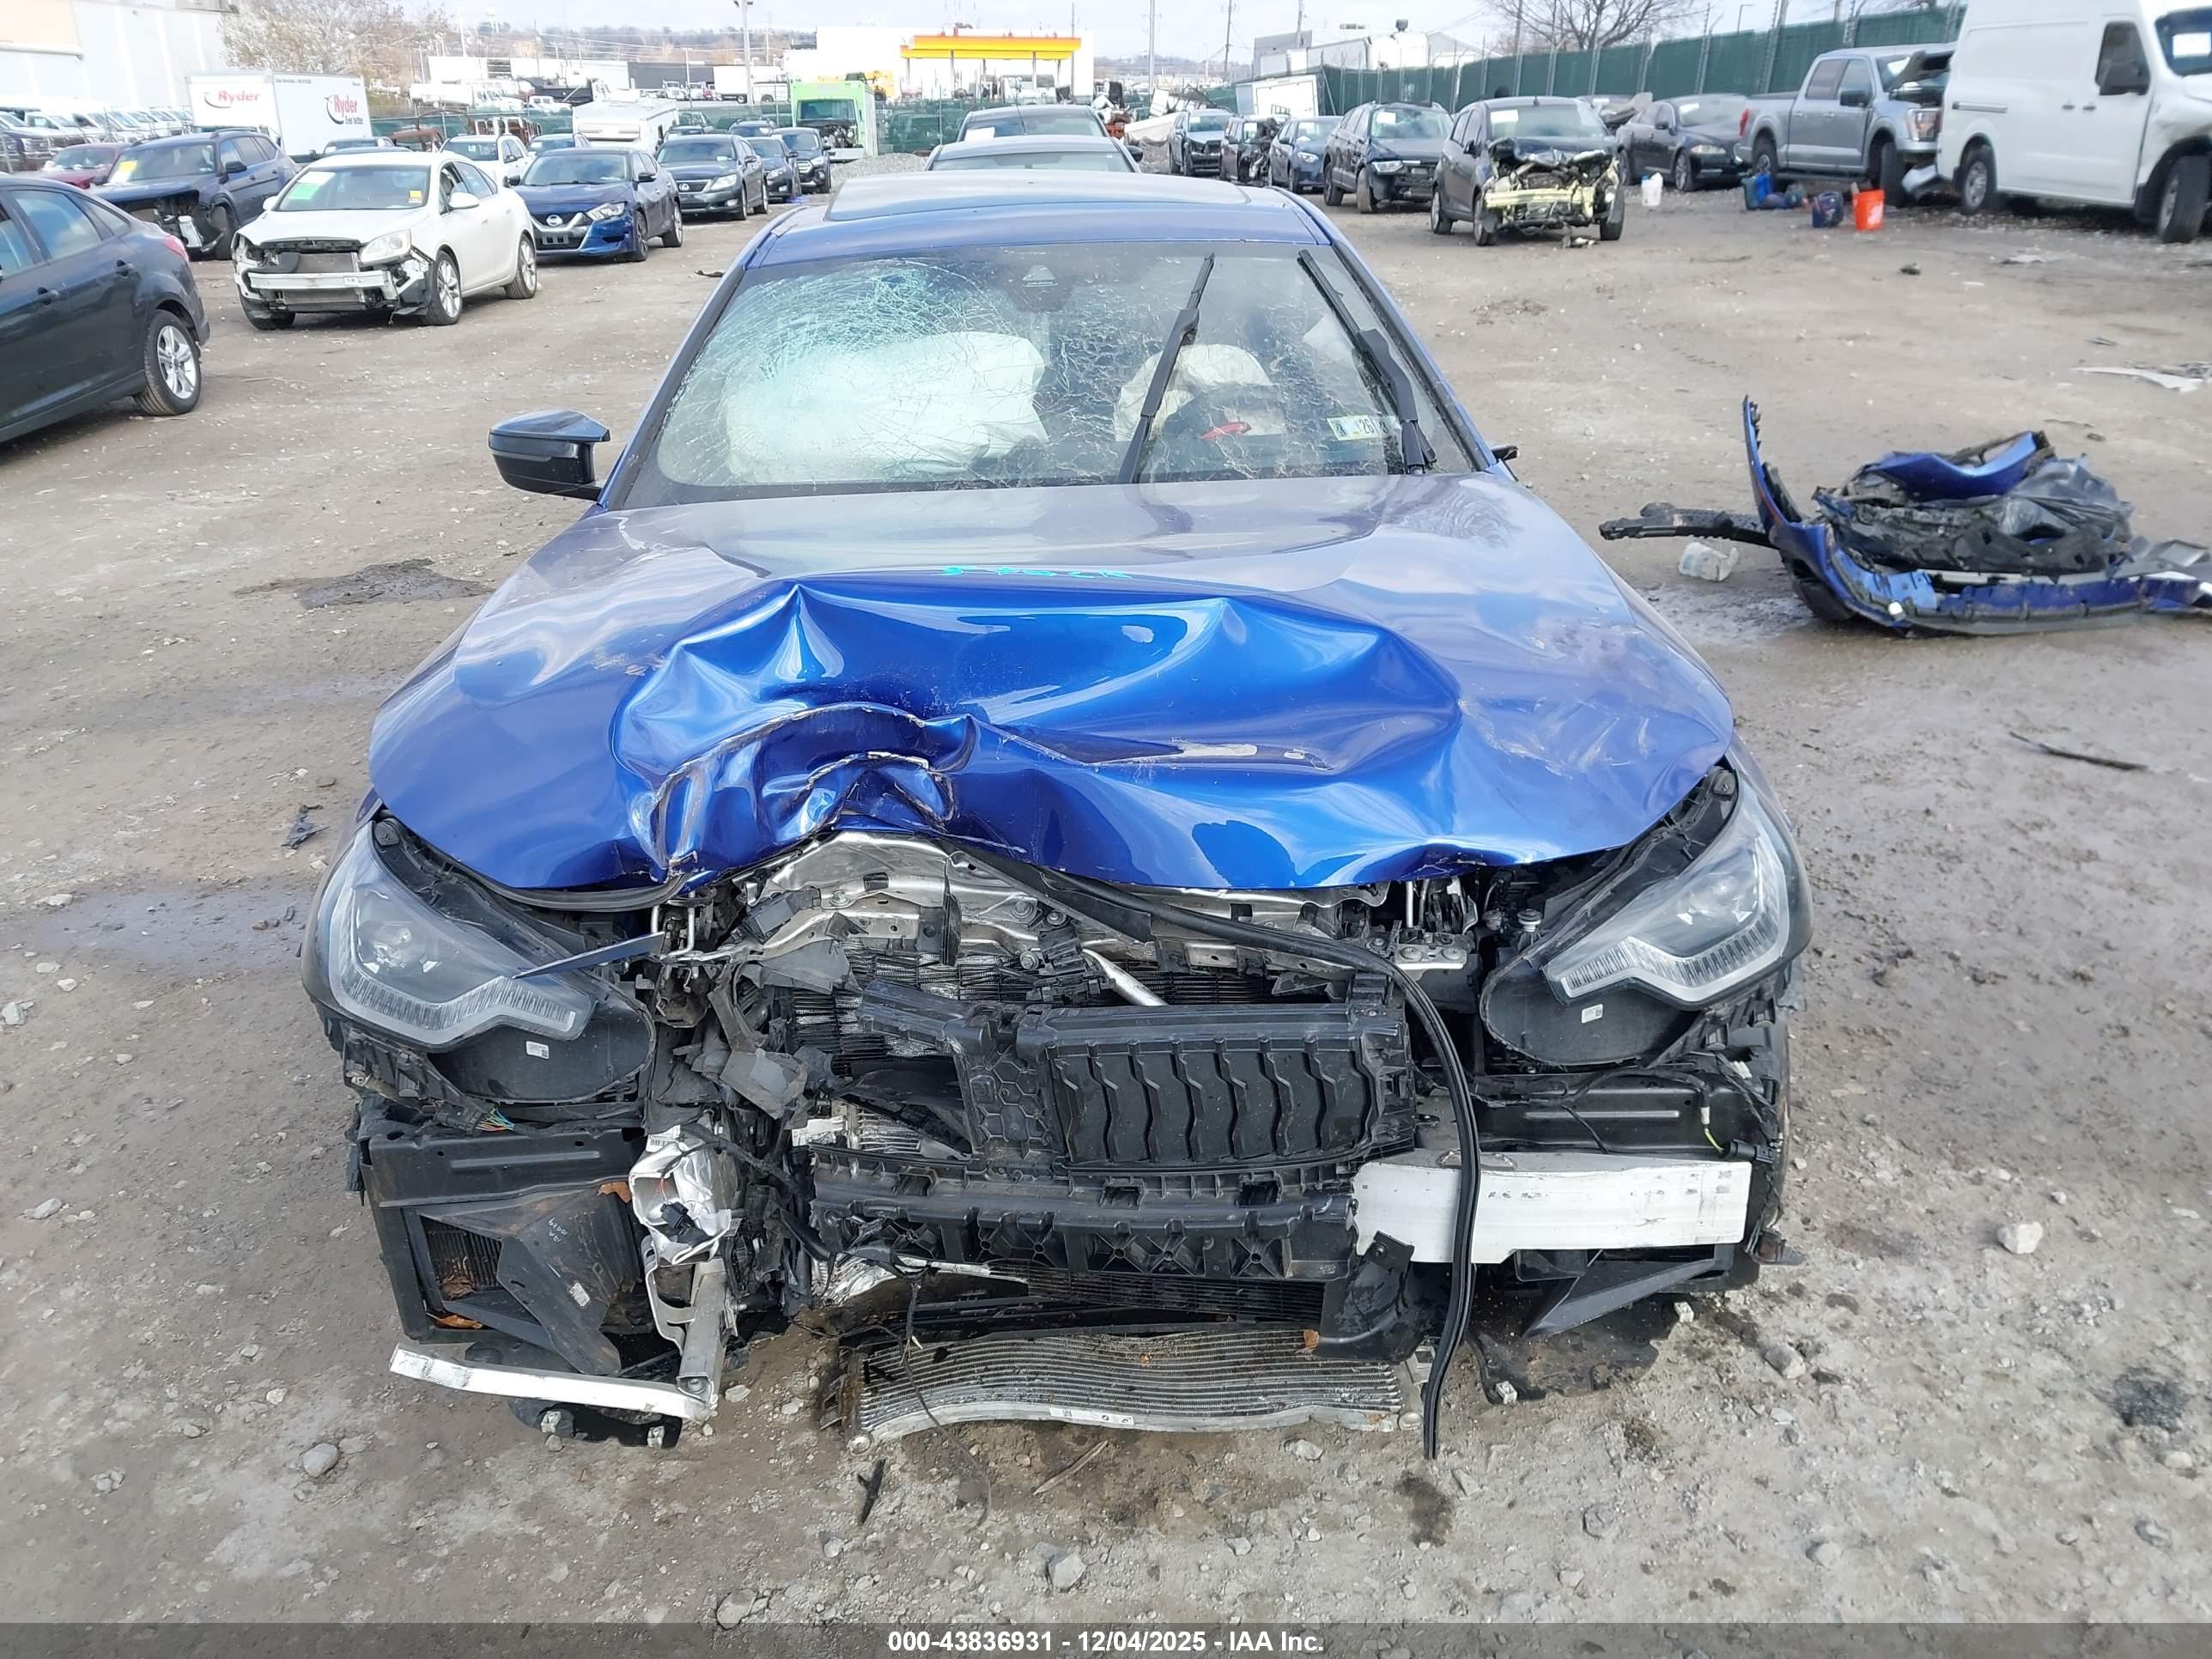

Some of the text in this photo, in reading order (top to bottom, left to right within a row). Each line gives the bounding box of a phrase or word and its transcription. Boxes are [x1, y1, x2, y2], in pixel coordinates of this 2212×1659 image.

[218, 89, 261, 104] Ryder
[333, 94, 358, 117] Ryder
[1359, 419, 1375, 434] 26
